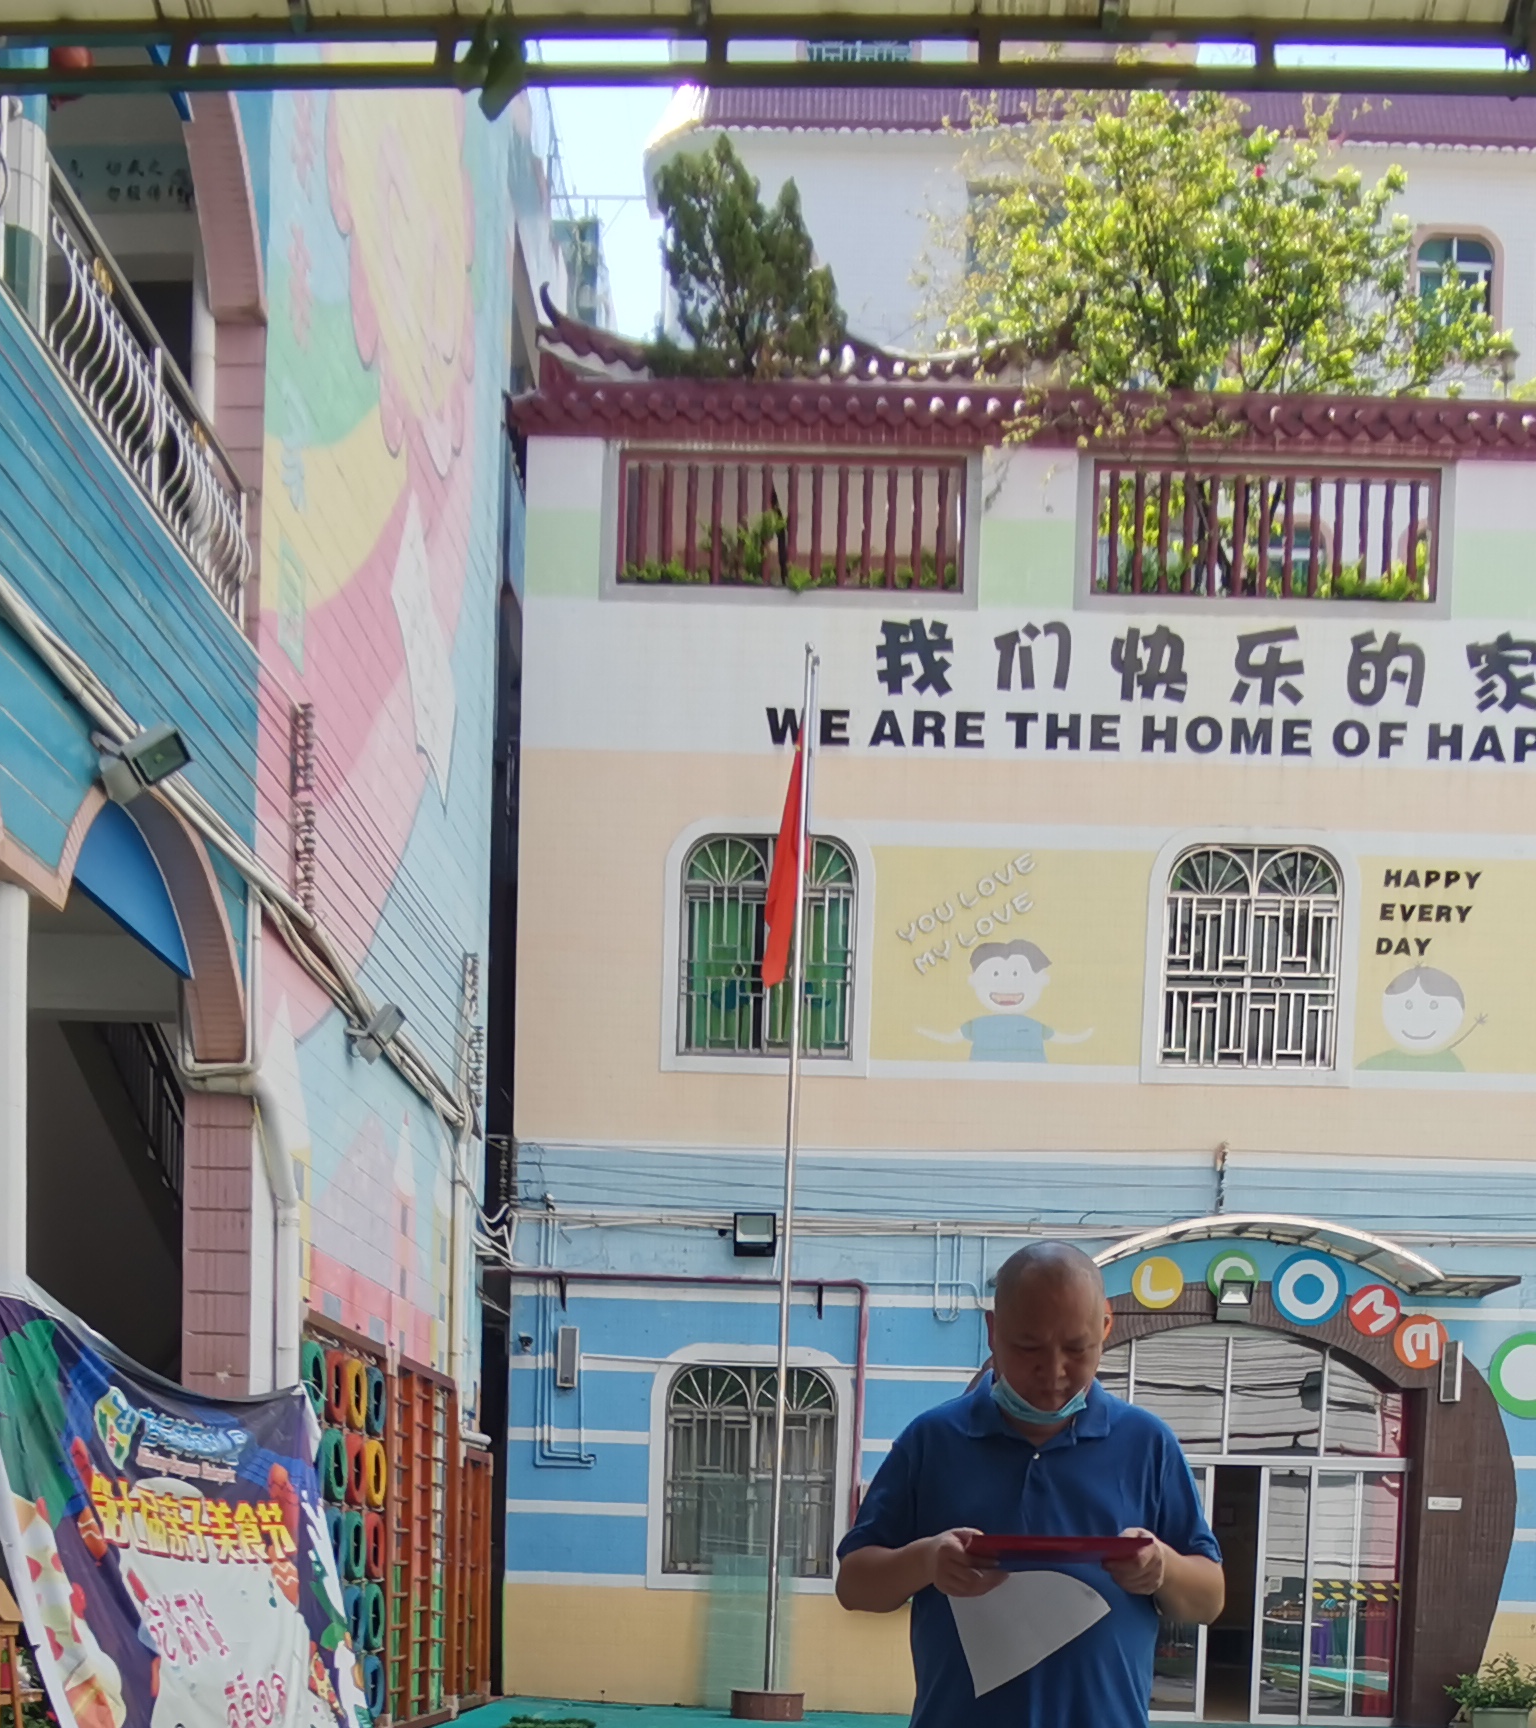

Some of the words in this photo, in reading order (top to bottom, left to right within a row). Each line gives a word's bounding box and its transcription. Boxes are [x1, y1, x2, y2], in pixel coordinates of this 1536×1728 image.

[766, 706, 851, 747] WE
[868, 709, 986, 748] ARE
[1005, 711, 1121, 752] THE
[1141, 715, 1313, 757] HOME
[1332, 719, 1408, 759] OF
[896, 901, 954, 945] YOU
[957, 852, 1037, 910] LOVE
[1383, 868, 1483, 890] HAPPY
[913, 939, 951, 976] MY
[956, 891, 1035, 949] LOVE
[1379, 902, 1474, 923] EVERY
[1375, 936, 1432, 957] DAY
[1138, 1255, 1442, 1364] LCOME
